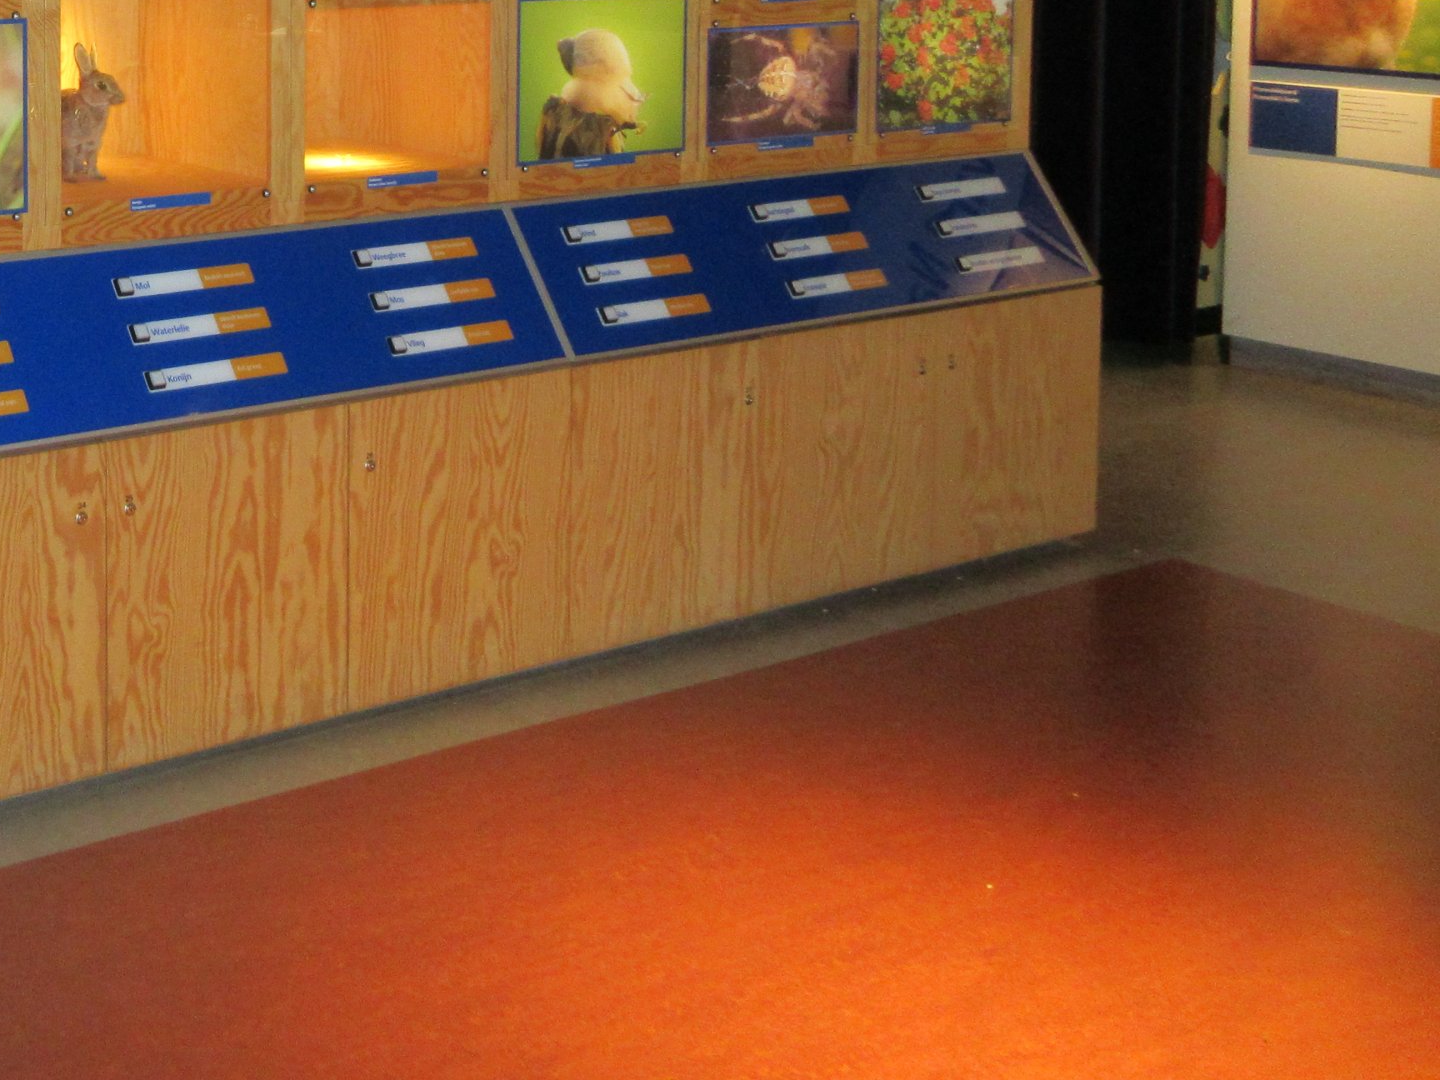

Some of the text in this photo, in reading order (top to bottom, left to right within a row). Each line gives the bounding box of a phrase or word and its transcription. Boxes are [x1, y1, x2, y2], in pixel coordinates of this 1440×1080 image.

[135, 280, 151, 291] Mol
[151, 323, 191, 337] Waterlelie
[167, 372, 192, 384] Konijn
